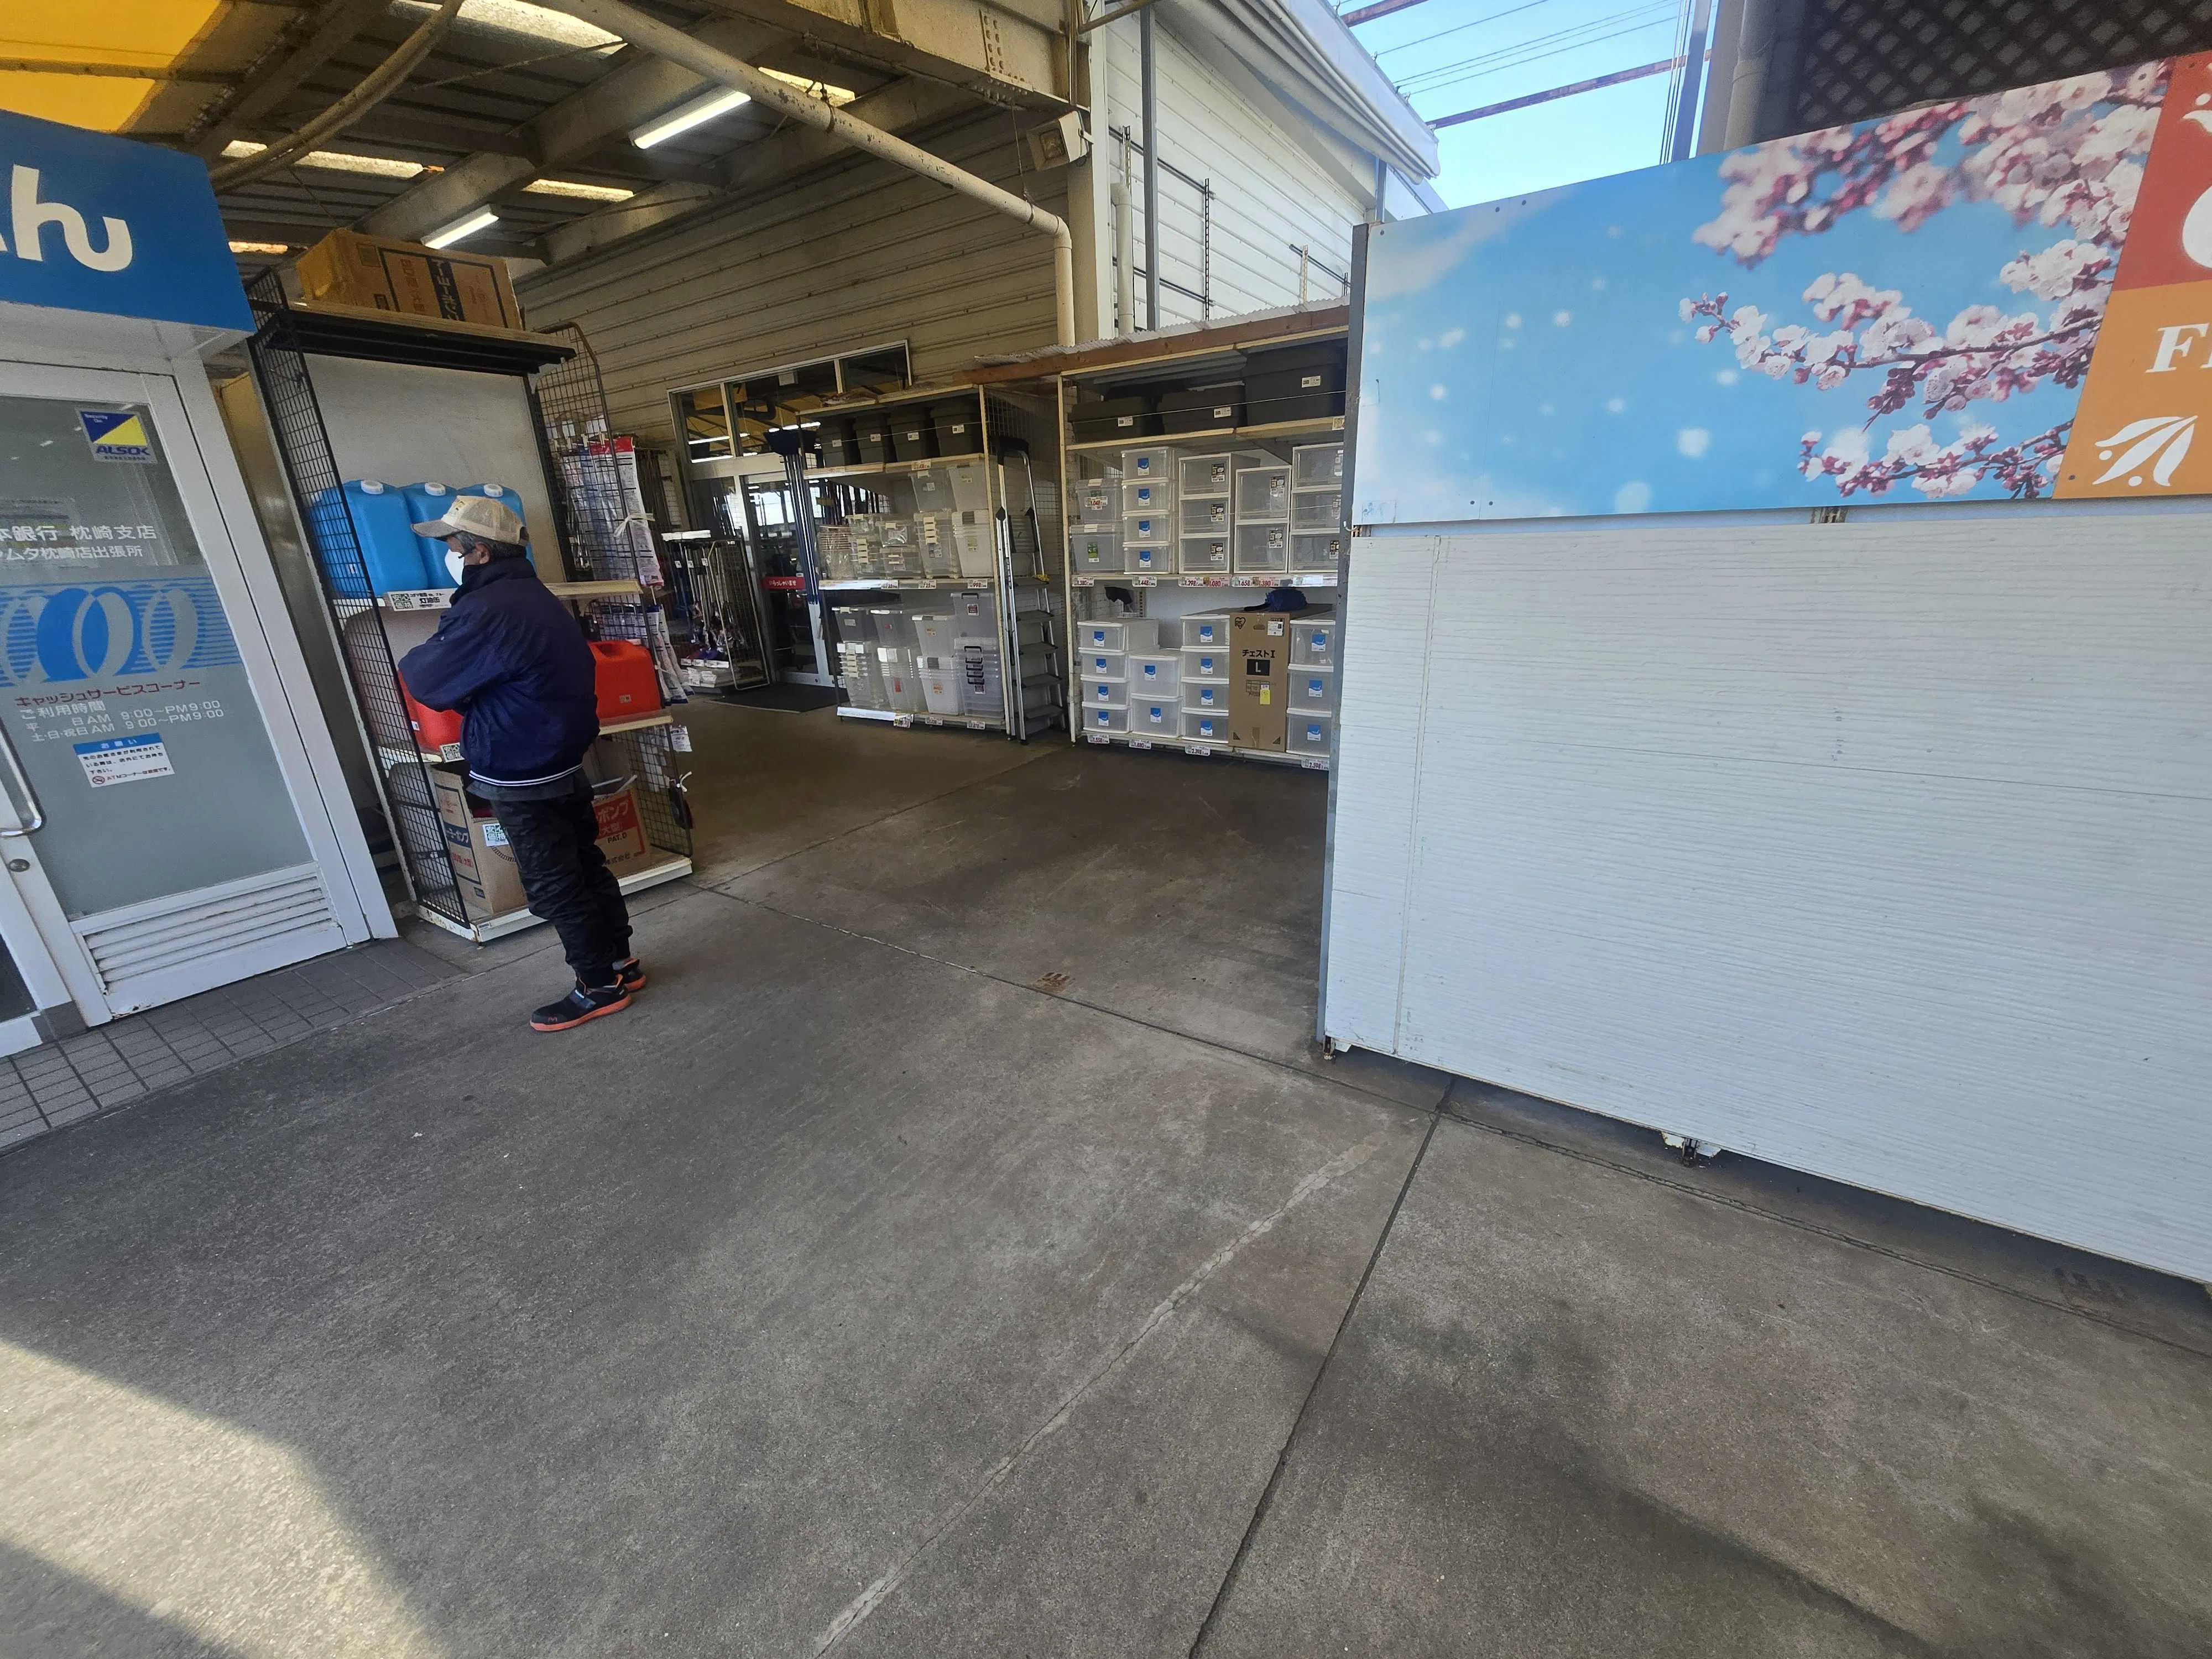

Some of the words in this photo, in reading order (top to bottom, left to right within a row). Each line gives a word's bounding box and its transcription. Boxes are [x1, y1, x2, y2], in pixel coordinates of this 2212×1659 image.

[2146, 322, 2212, 374] F
[96, 446, 150, 456] ALSOK
[69, 524, 157, 540] 枕崎支店
[0, 545, 143, 561] ムタ枕崎店出張所
[1255, 662, 1261, 672] L
[14, 680, 200, 706] キャッシュサービスコーナー
[20, 701, 107, 720] ご利用時間
